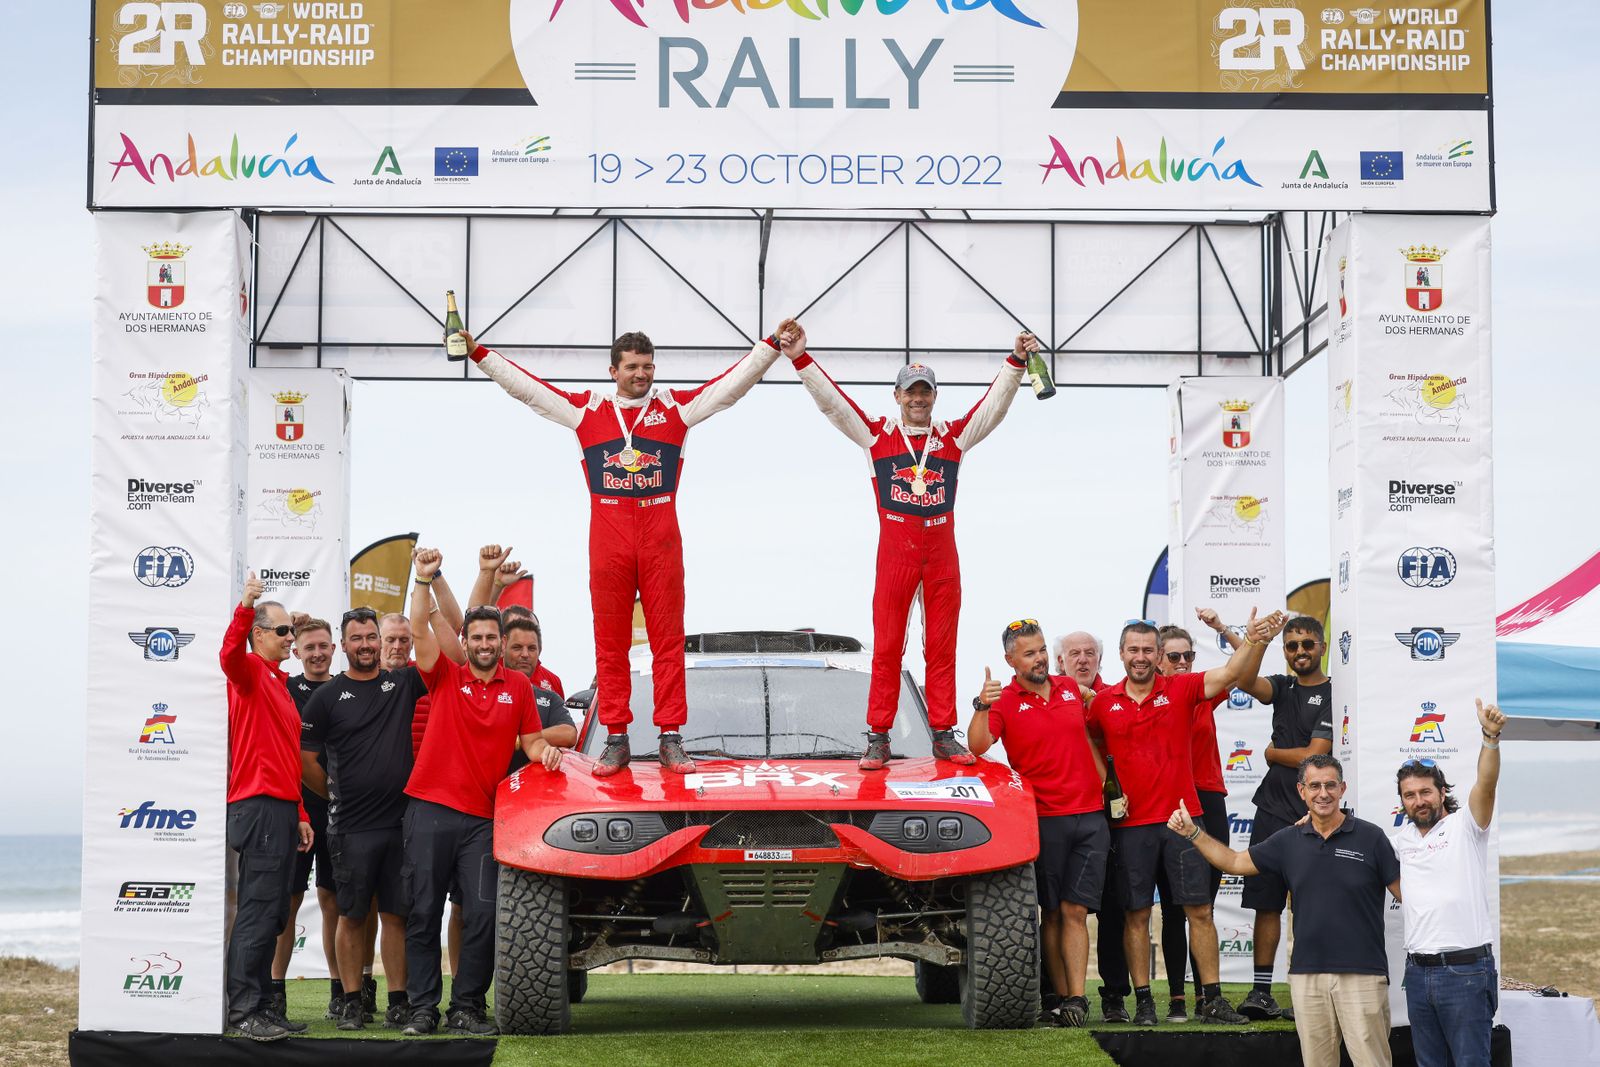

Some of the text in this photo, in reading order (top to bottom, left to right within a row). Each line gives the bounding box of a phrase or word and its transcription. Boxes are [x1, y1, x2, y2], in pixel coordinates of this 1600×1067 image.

[293, 3, 363, 20] WORLD
[1388, 9, 1458, 25] WORLD
[118, 2, 207, 66] 2R
[222, 23, 370, 45] RALLY-RAID
[1219, 8, 1306, 70] 2R
[1320, 29, 1466, 50] RALLY-RAID
[222, 49, 375, 66] CHAMPIONSHIP
[1321, 54, 1471, 71] CHAMPIONSHIP
[658, 37, 945, 109] RALLY
[109, 132, 336, 184] Andalucía
[530, 156, 549, 164] Europa
[1039, 134, 1264, 187] Andalucía
[588, 153, 622, 185] 19
[665, 154, 708, 185] 23
[719, 154, 905, 186] OCTOBER
[915, 155, 1003, 186] 2022
[353, 178, 373, 186] Junta
[386, 177, 422, 185] Andalucía
[1313, 181, 1349, 189] Andalucía
[119, 312, 213, 321] AYUNTAMIENTO DE
[1379, 314, 1471, 325] AYUNTAMIENTO DE
[125, 324, 206, 333] DOS HERMANAS
[1385, 326, 1464, 336] DOS HERMANAS
[129, 371, 147, 379] Gran
[127, 478, 195, 494] Diverse
[603, 470, 662, 490] Red Bull
[1388, 480, 1456, 495] Diverse
[127, 493, 195, 503] ExtremeTeam
[921, 486, 946, 507] Bull
[1388, 494, 1456, 504] ExtremeTeam
[1388, 504, 1412, 512] .com
[260, 569, 311, 580] Diverse
[1210, 575, 1260, 586] Diverse
[150, 637, 173, 652] FIM
[1417, 637, 1439, 651] FIM
[1231, 693, 1248, 703] FIM
[684, 771, 849, 790] BRX
[945, 785, 979, 798] 201
[119, 800, 197, 829] rfme
[754, 851, 780, 859] 648833
[123, 974, 183, 990] FAM
